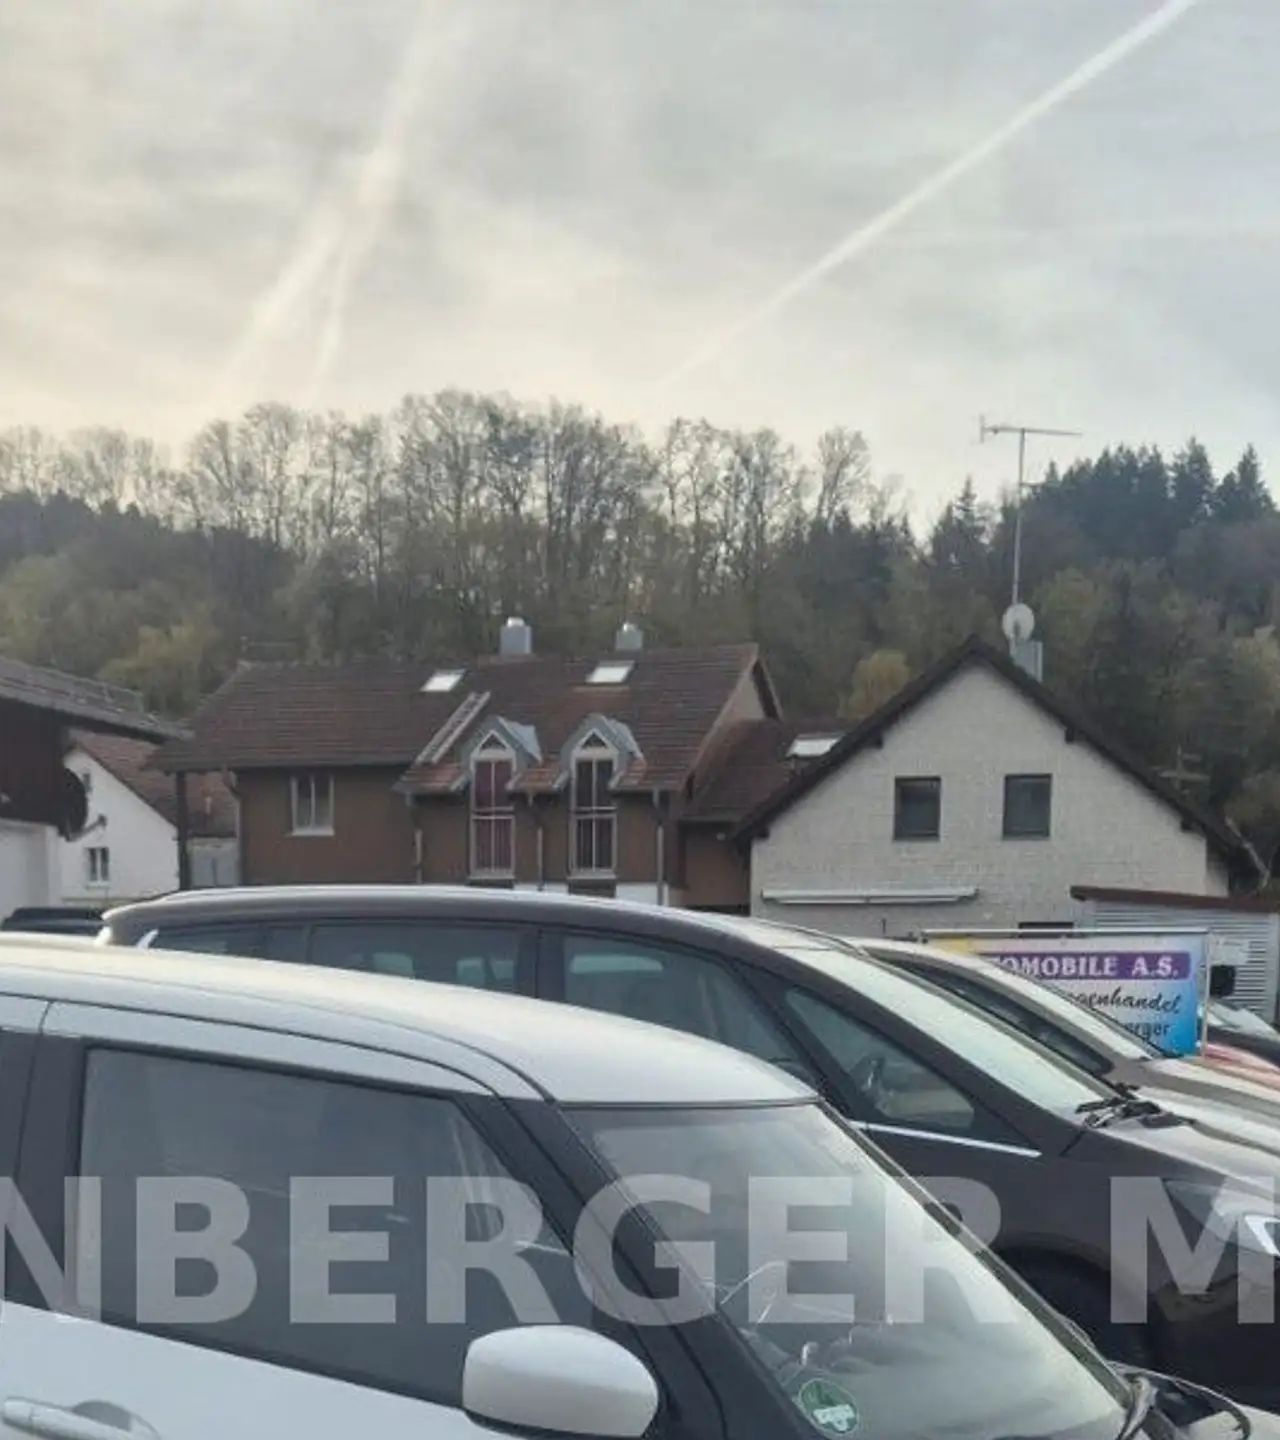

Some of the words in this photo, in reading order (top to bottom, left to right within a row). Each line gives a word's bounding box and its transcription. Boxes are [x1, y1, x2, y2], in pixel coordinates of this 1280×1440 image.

[987, 956, 1116, 977] OMOBILE
[1131, 956, 1179, 977] A.S.
[1068, 986, 1182, 1014] agenhandel
